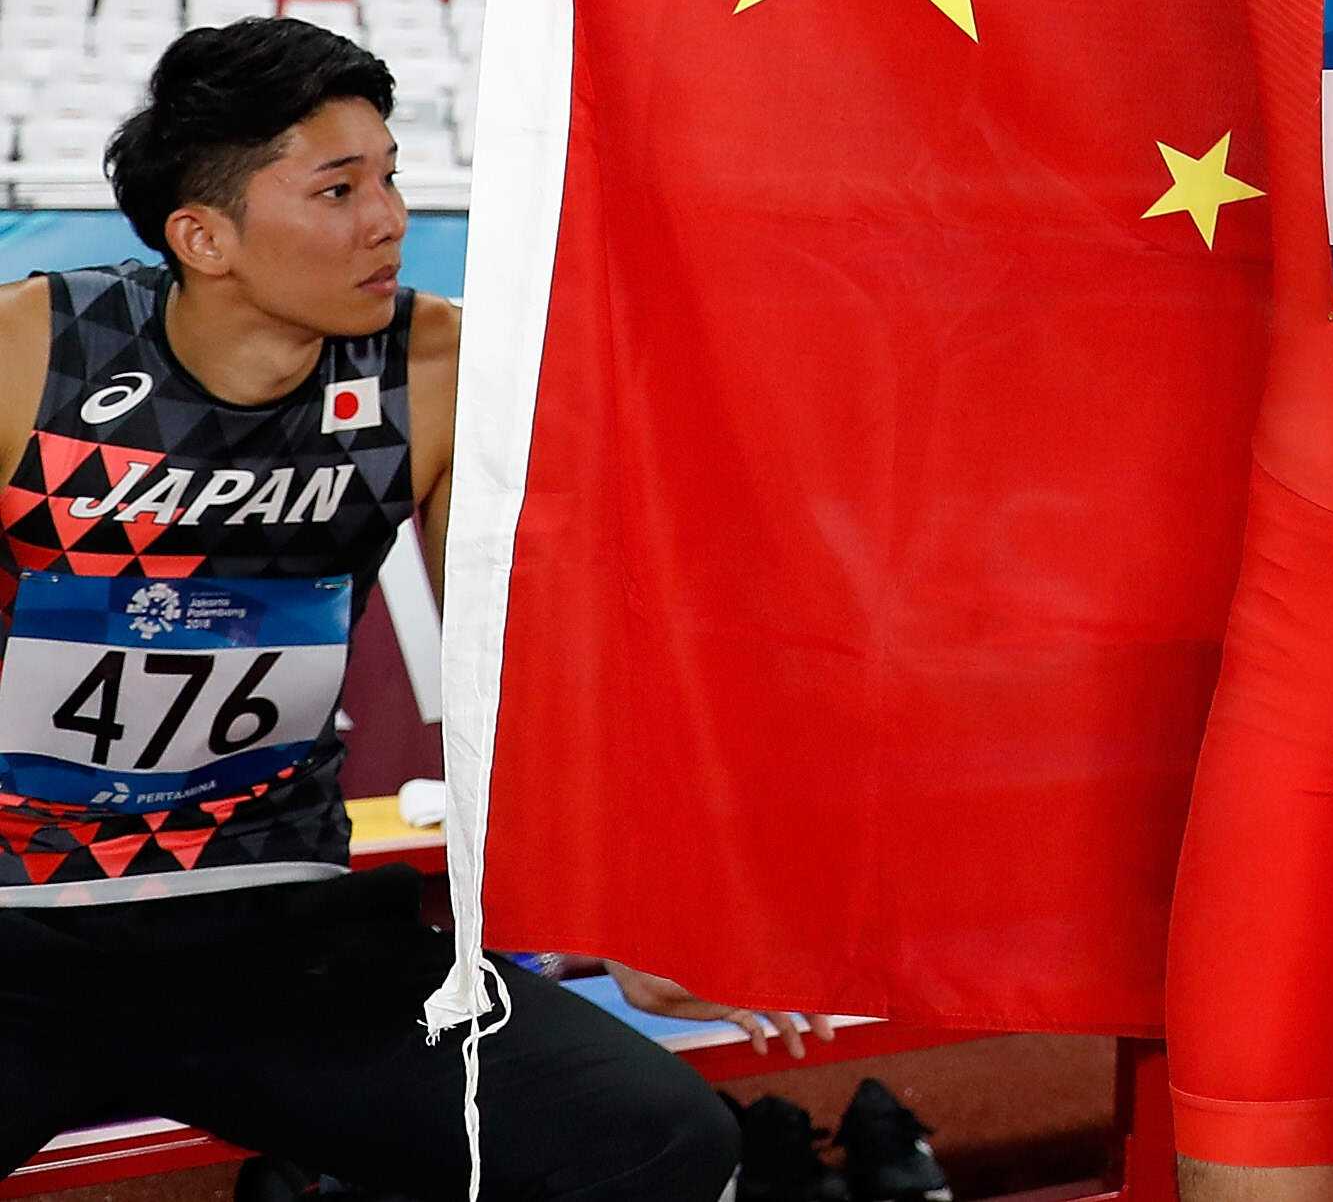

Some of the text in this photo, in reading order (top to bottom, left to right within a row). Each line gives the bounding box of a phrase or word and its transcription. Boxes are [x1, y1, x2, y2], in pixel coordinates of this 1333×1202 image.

[68, 461, 356, 526] JAPAN
[52, 650, 284, 770] 476
[135, 779, 218, 805] PERTAMINA
